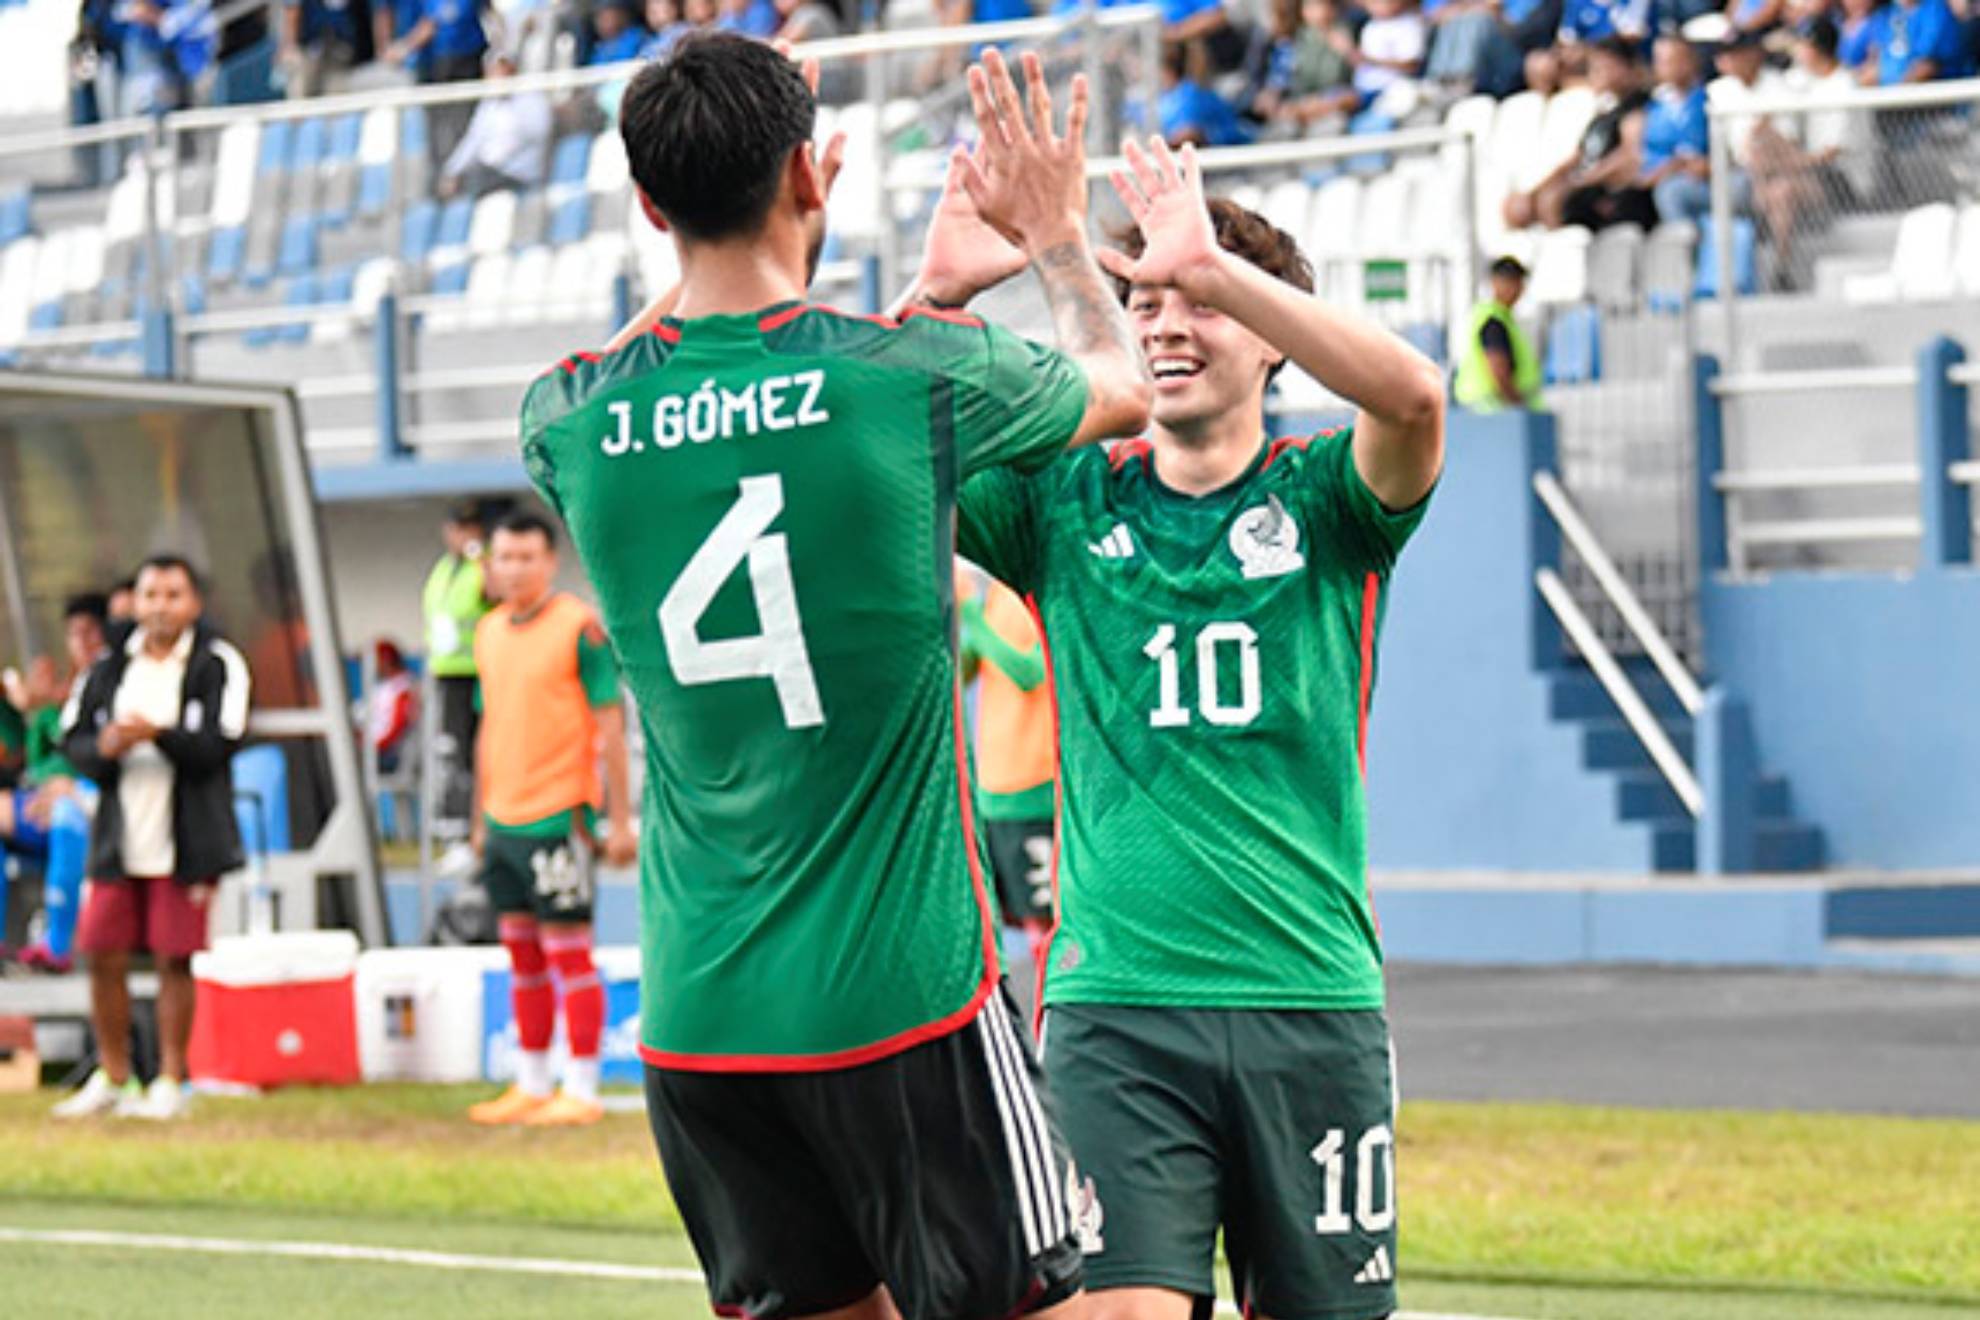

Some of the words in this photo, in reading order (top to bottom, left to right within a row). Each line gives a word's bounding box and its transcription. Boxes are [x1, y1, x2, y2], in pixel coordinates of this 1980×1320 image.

[601, 400, 645, 456] J.
[653, 369, 829, 449] GÓMEZ
[658, 473, 826, 729] 4
[1143, 621, 1262, 727] 10
[1311, 1125, 1394, 1233] 10
